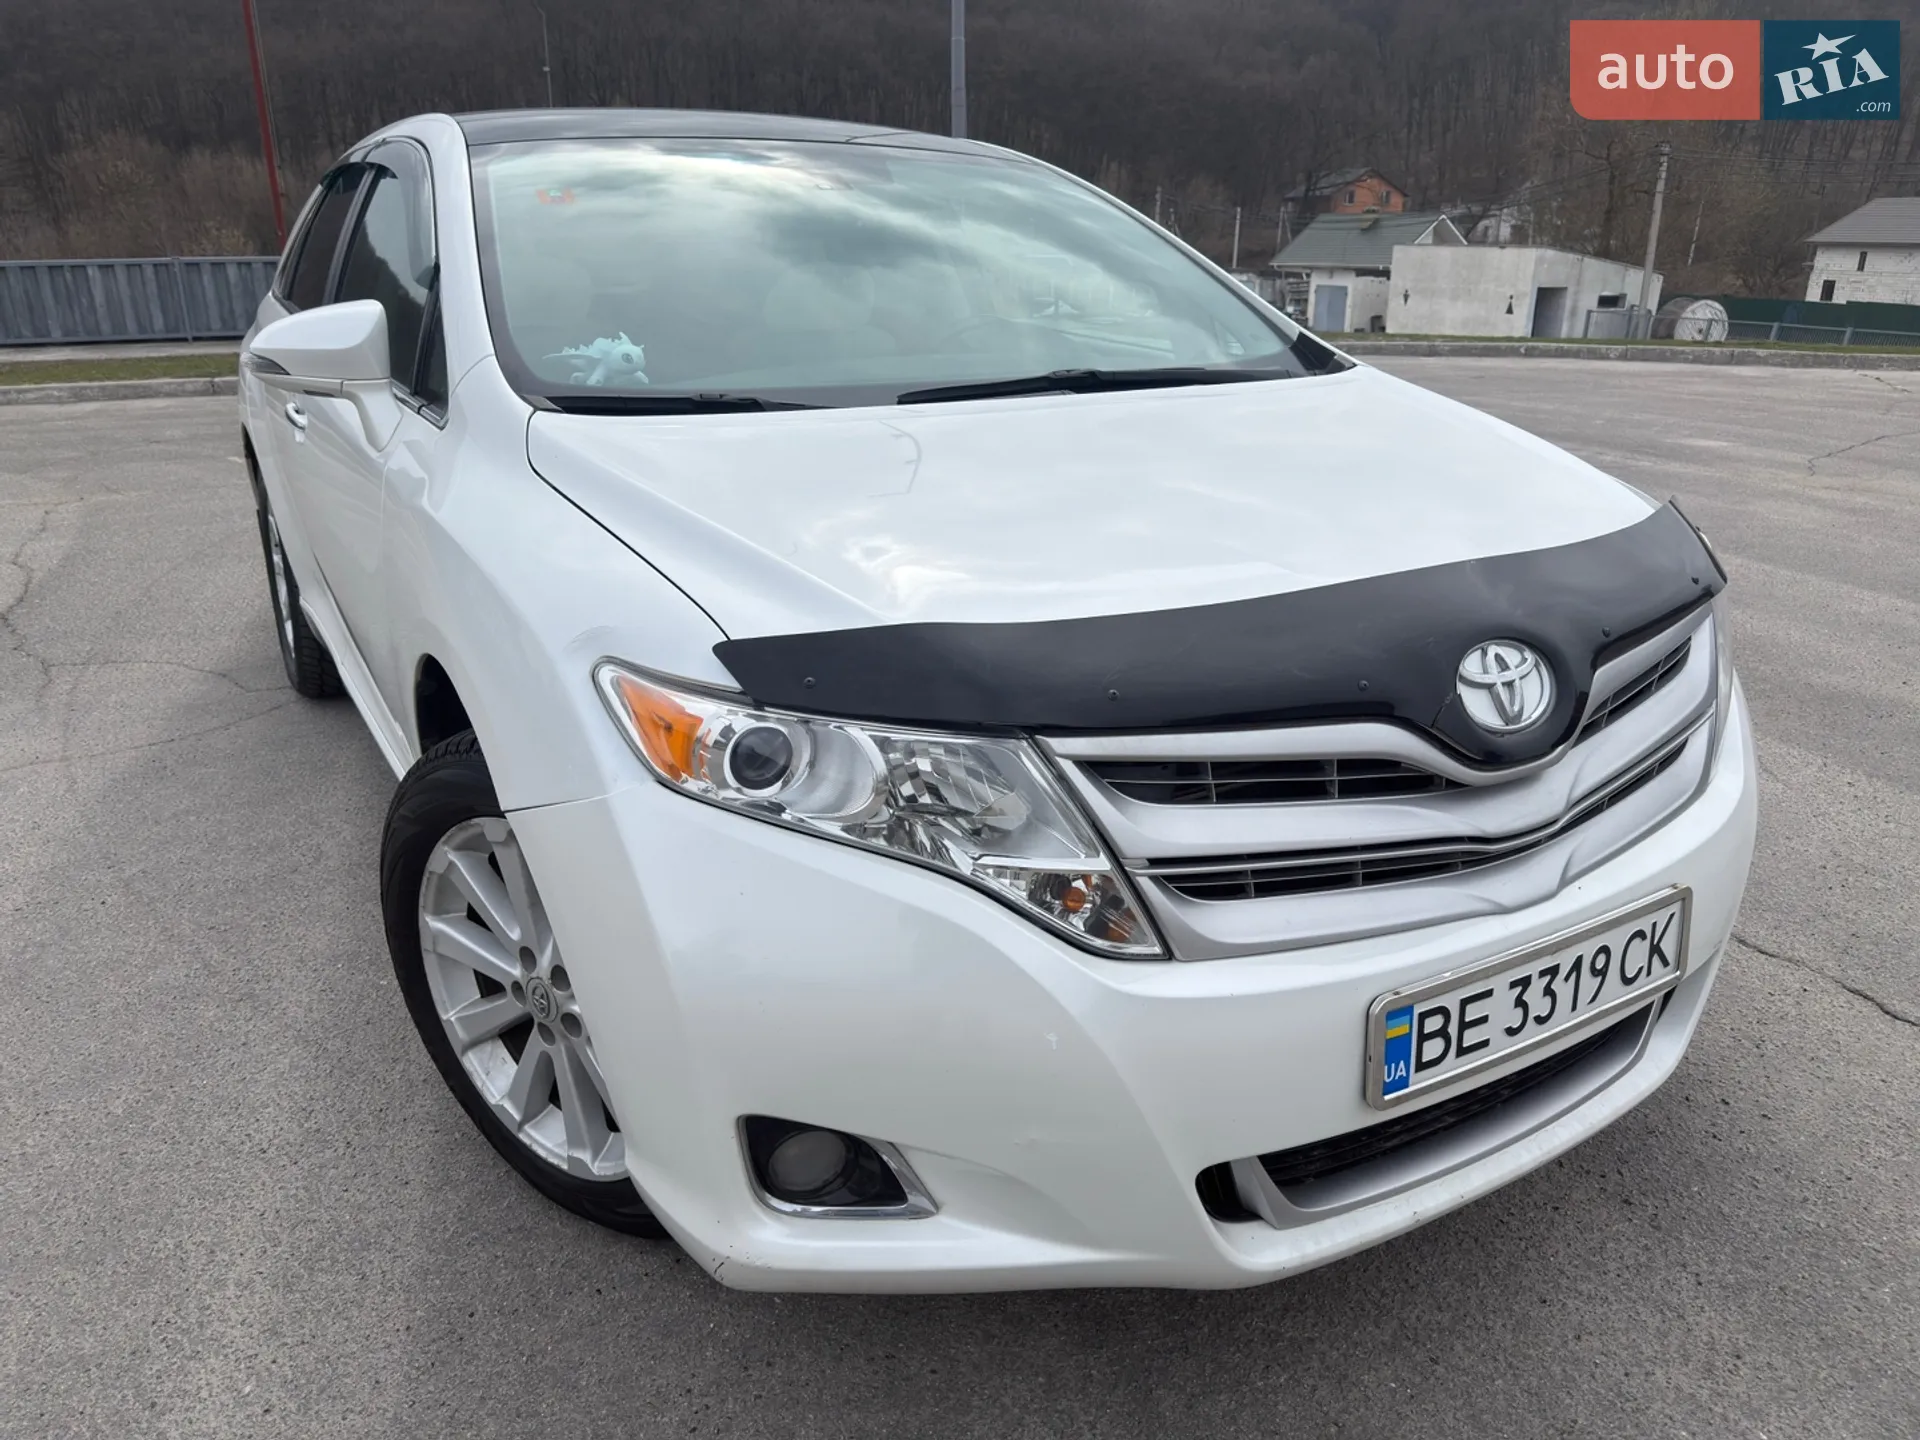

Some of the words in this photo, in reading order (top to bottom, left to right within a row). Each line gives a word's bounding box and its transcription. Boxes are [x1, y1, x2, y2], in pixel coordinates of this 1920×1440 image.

[1414, 988, 1494, 1073] BE
[1504, 944, 1612, 1037] 3319
[1619, 911, 1676, 986] CK
[1384, 1060, 1407, 1083] UA
